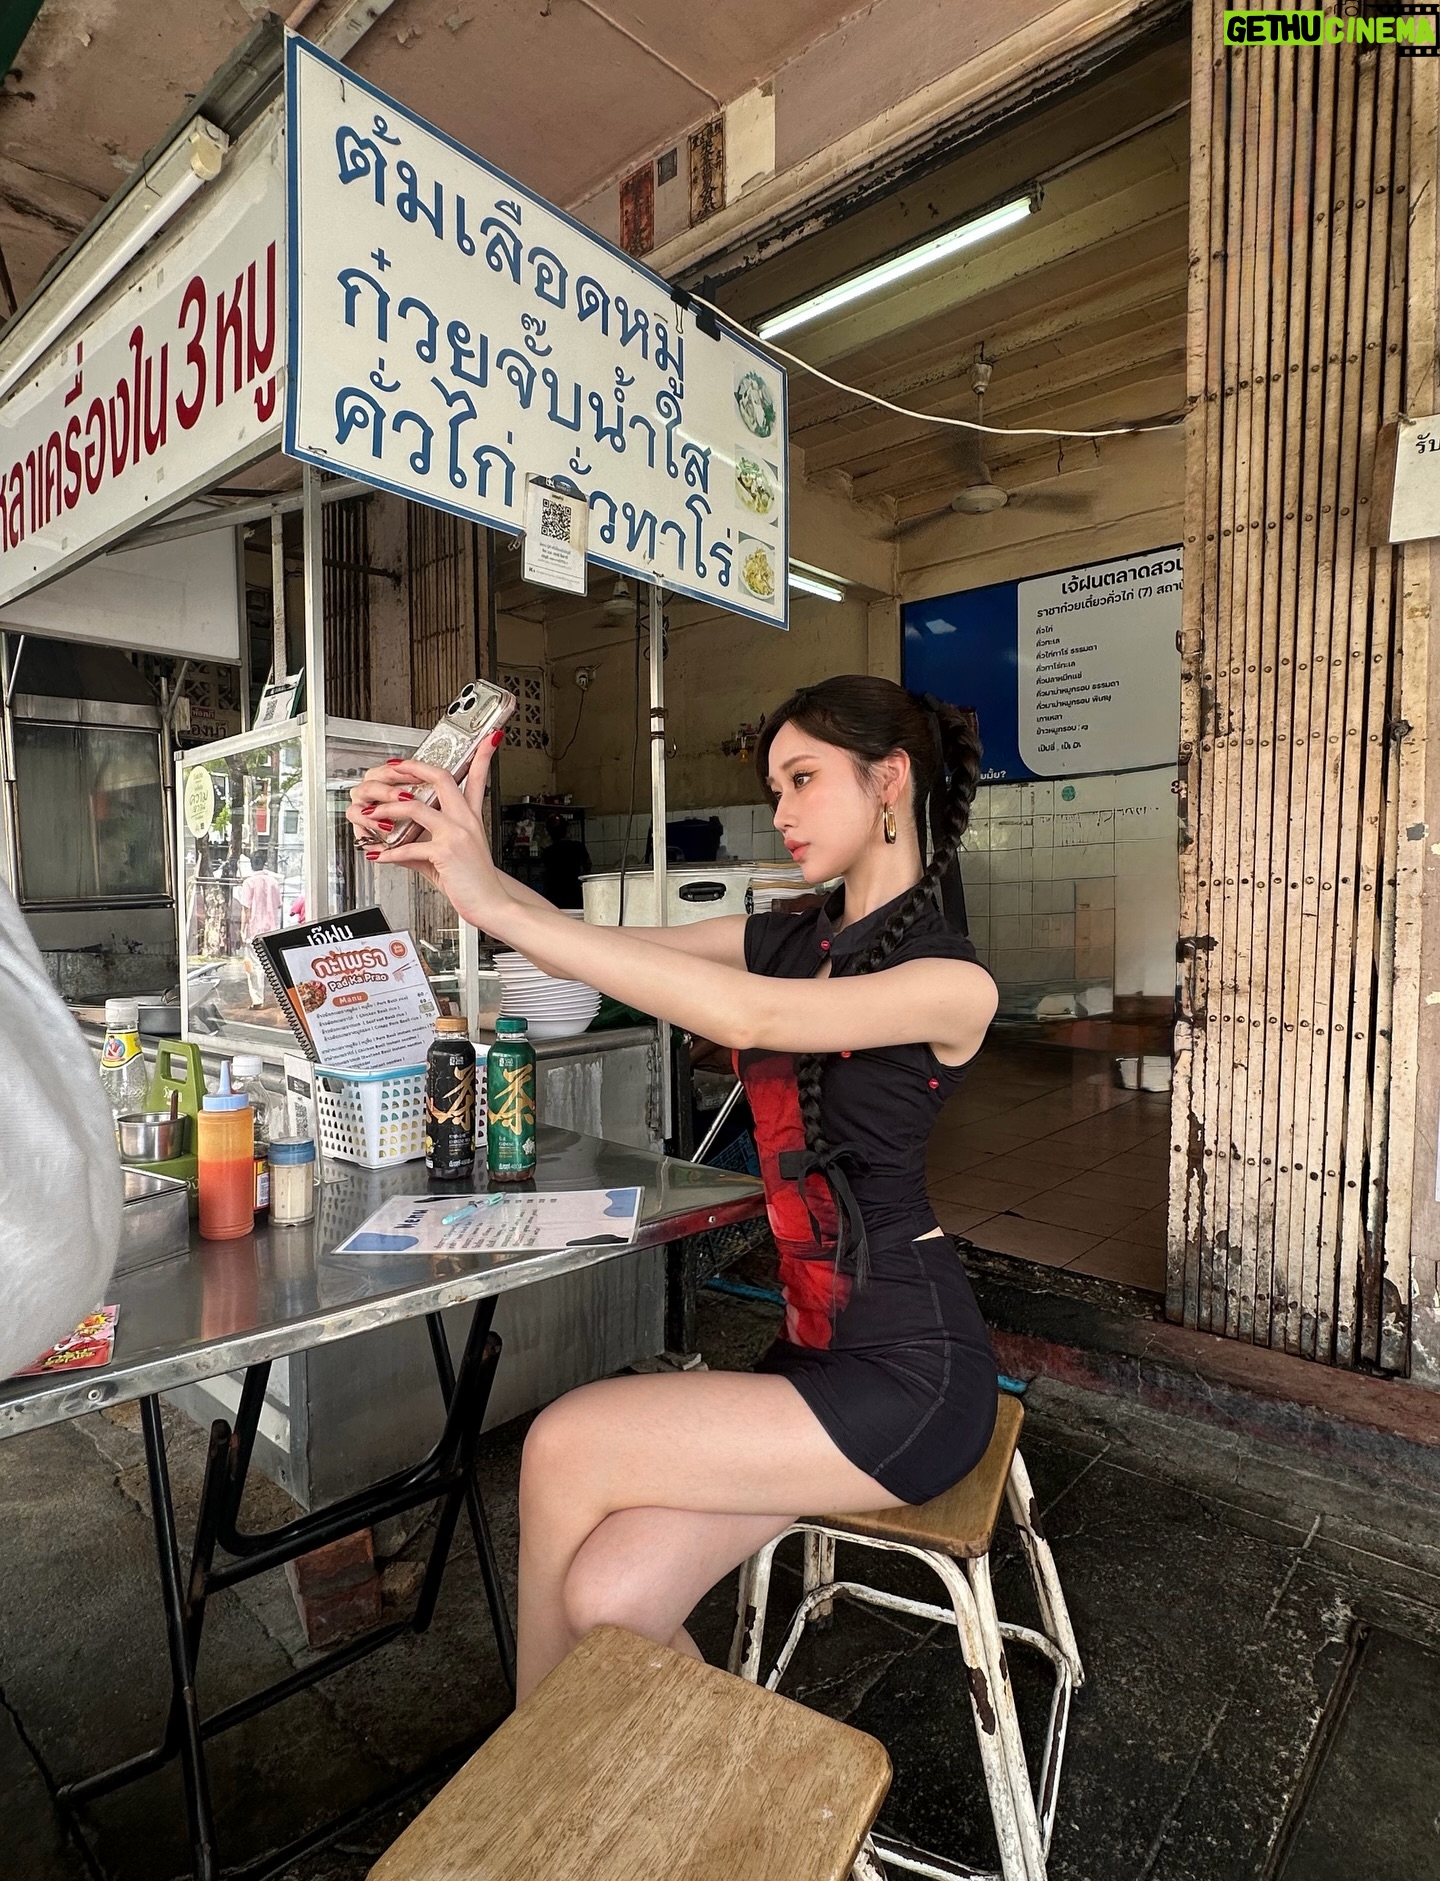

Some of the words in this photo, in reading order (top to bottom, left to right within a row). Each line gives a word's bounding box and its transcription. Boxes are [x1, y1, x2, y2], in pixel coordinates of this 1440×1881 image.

[334, 114, 685, 399] ต้มเลือดหมู
[336, 248, 711, 494] ก๋วยจั๊บน้ำใส
[335, 357, 516, 508] คั่วไก่
[1138, 585, 1153, 600] (7)
[312, 946, 388, 978] กะเพรา
[328, 978, 349, 992] Pad
[349, 975, 365, 986] Ka
[364, 972, 388, 984] Prao
[487, 1063, 536, 1136] 茶
